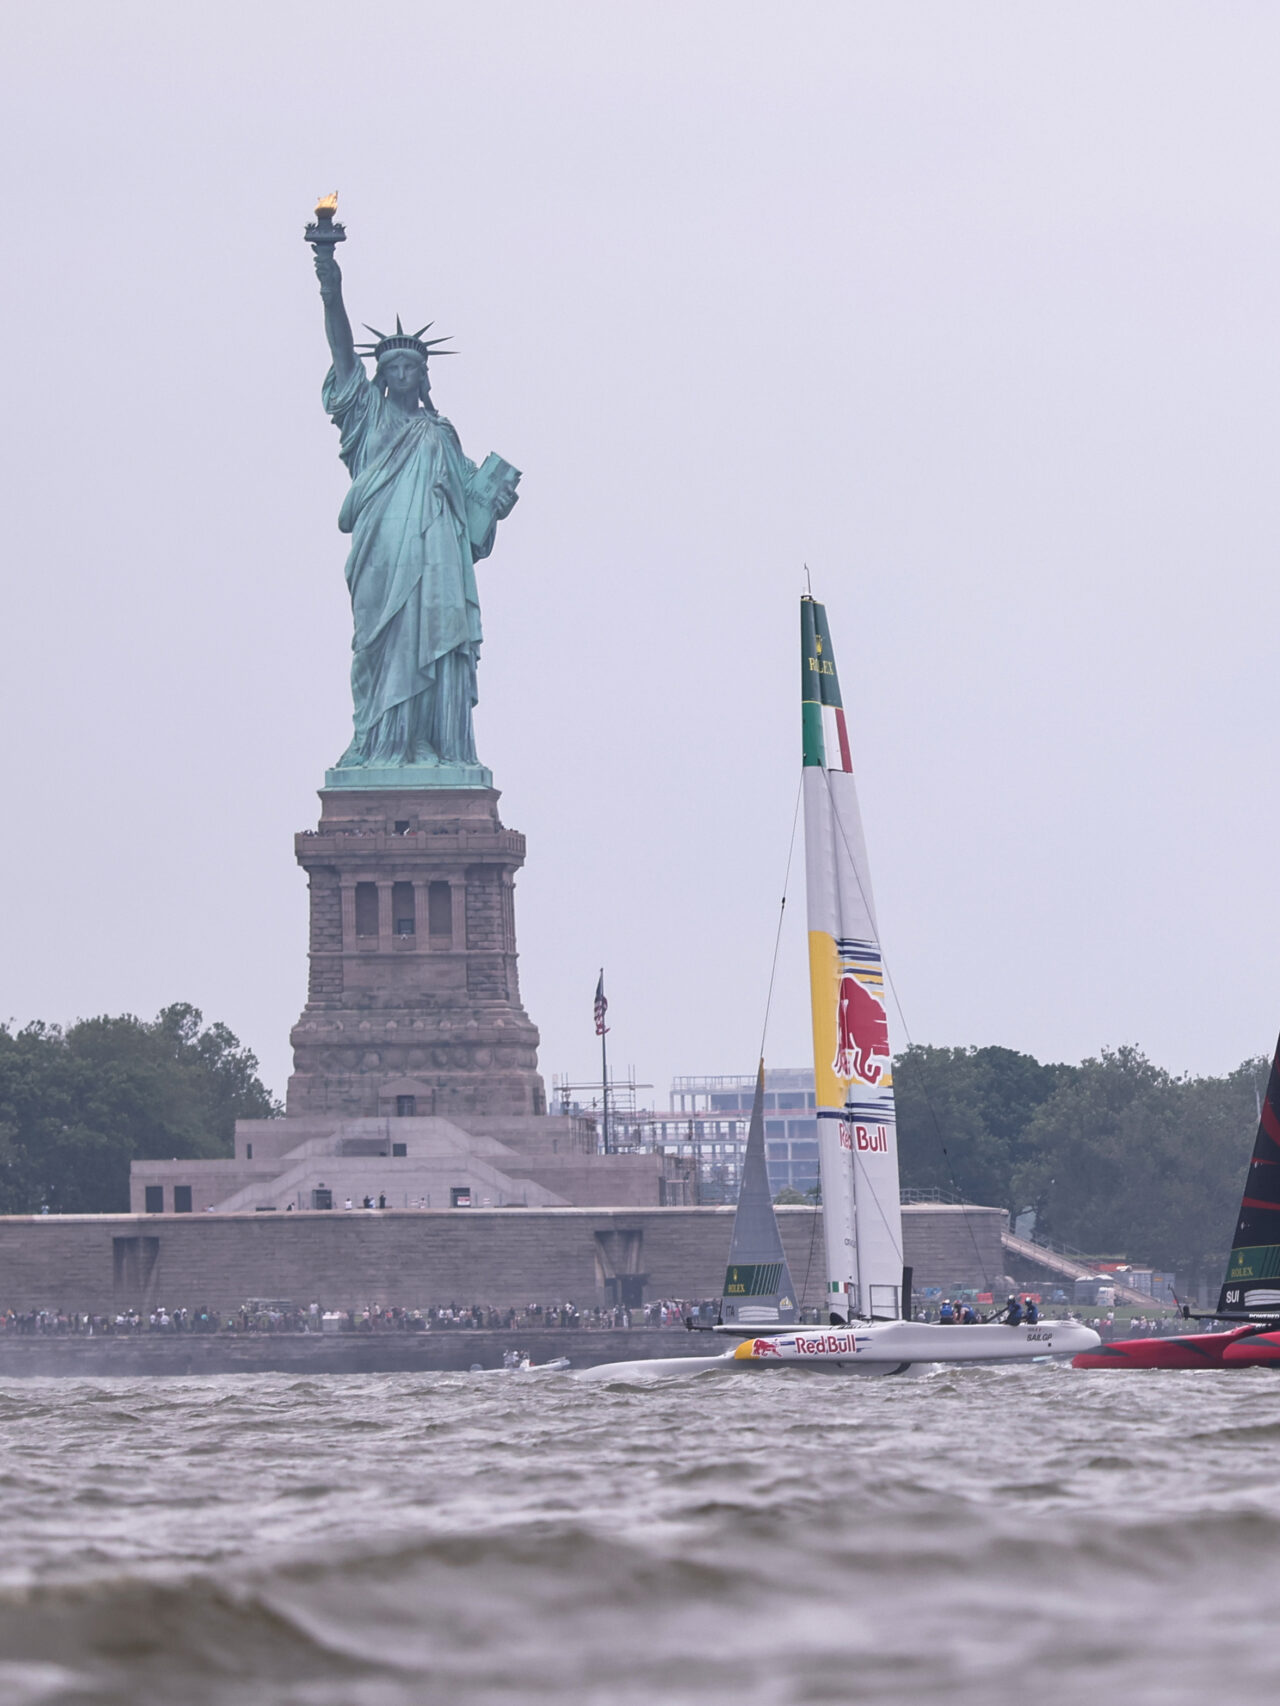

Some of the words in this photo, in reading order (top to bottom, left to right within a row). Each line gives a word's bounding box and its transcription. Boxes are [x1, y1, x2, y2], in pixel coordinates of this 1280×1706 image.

[856, 1125, 888, 1152] Bull
[1231, 1266, 1254, 1278] ROLEX
[1226, 1290, 1241, 1304] SUI
[795, 1336, 826, 1354] Red
[827, 1334, 857, 1353] Bull
